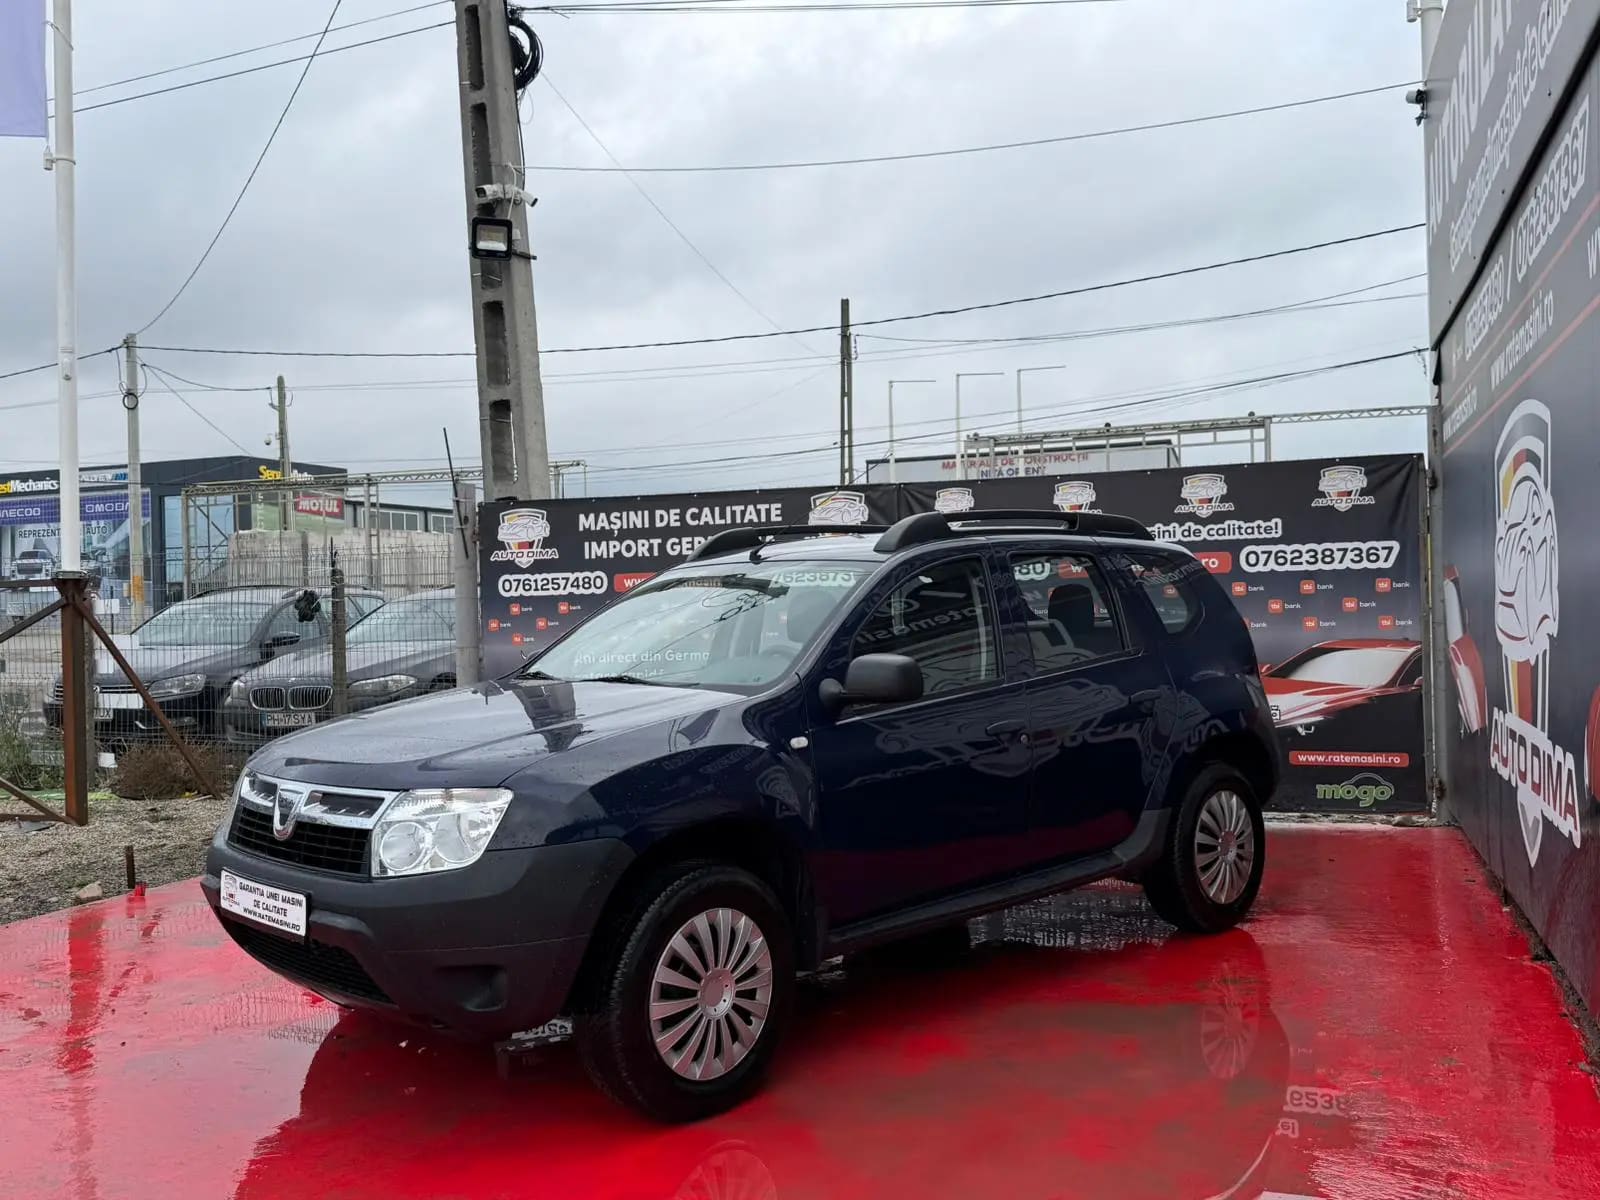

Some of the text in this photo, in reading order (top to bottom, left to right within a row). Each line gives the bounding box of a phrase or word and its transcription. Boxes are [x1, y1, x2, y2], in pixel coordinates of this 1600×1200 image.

[298, 498, 340, 513] MOTUL
[1176, 503, 1234, 513] AUTO DIMA
[1313, 496, 1375, 507] AUTO DIMA
[578, 503, 783, 537] MAȘINI DE CALITATE
[18, 526, 108, 539] REPREZENT AUTO
[1181, 525, 1202, 538] de
[1206, 521, 1280, 538] calitate!
[491, 548, 558, 561] AUTO DIMA
[584, 538, 662, 560] IMPORT
[1244, 545, 1394, 568] 0762387367
[501, 575, 604, 593] 0761257480
[1297, 753, 1401, 765] www.ratemasini.ro
[1491, 715, 1579, 834] AUTO DIMA
[1316, 784, 1393, 808] mogo
[239, 881, 304, 908] GARANTIA UNEI MASINI
[253, 899, 288, 917] DE CALITATE
[243, 906, 301, 932] WWW.RATEMASINI.RO
